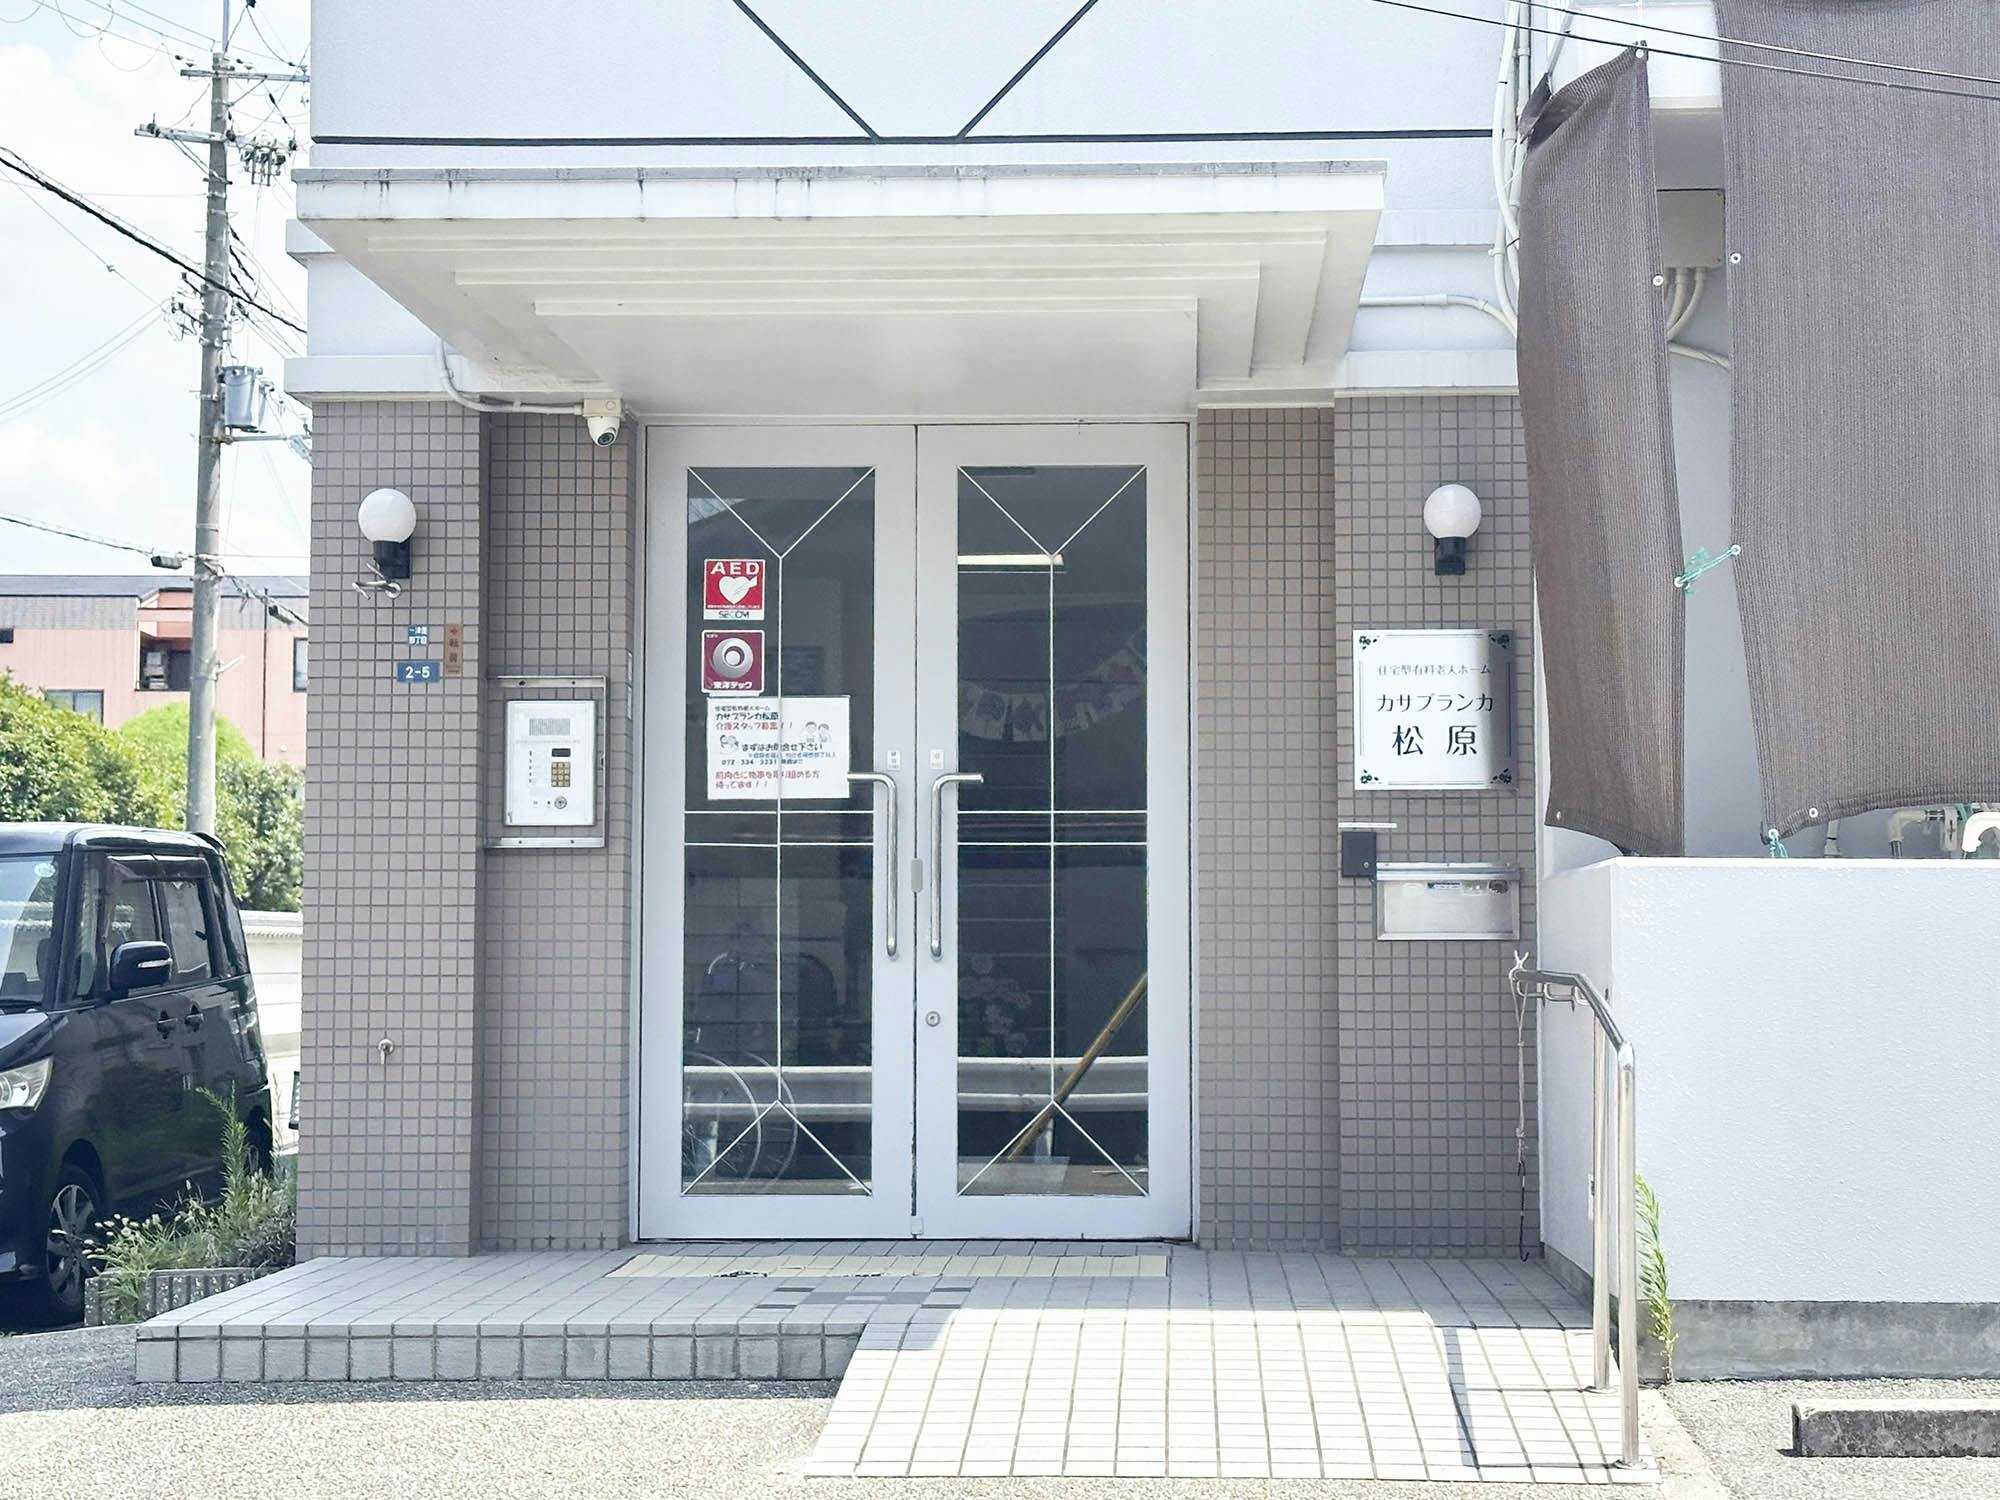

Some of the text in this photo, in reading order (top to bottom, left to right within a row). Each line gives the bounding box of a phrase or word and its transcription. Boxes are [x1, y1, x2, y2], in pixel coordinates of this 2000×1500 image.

[710, 561, 760, 575] AED
[405, 666, 430, 679] 2-5
[1378, 664, 1492, 676] 住宅型有料老人ホーム
[1377, 693, 1494, 713] カサブランカ
